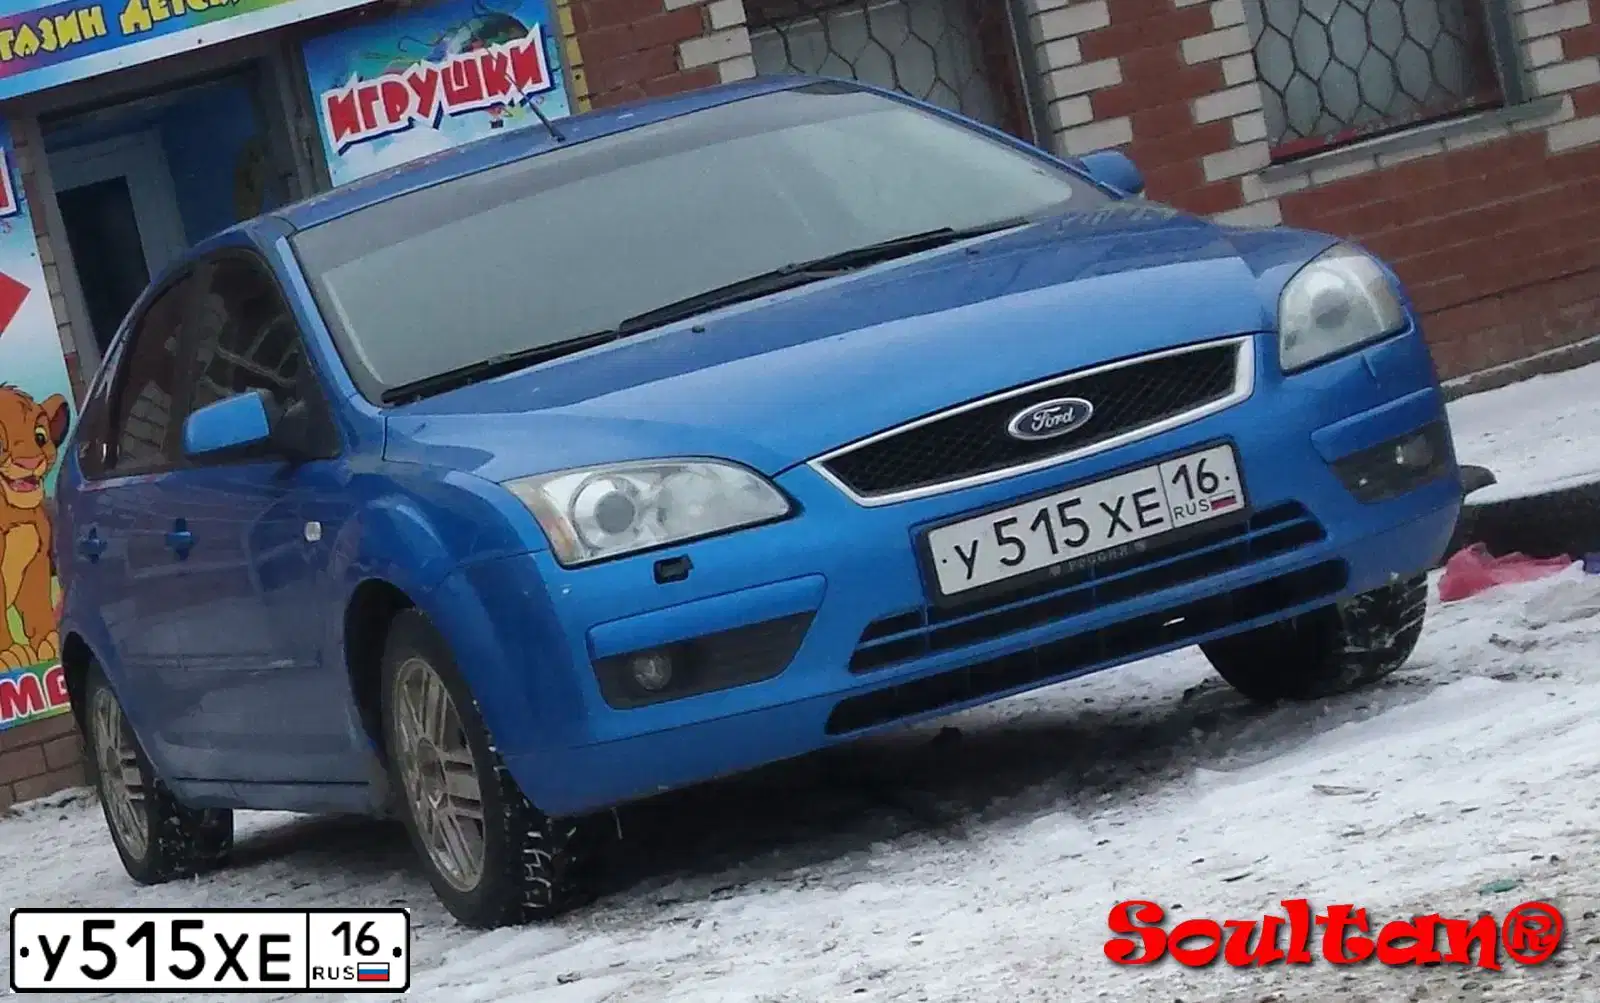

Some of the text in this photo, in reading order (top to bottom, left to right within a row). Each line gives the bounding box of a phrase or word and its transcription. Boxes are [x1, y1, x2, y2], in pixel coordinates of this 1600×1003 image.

[327, 38, 543, 143] ИГРУШКИ
[1031, 406, 1075, 432] Ford
[1171, 457, 1219, 500] 16
[1173, 499, 1210, 520] RUS
